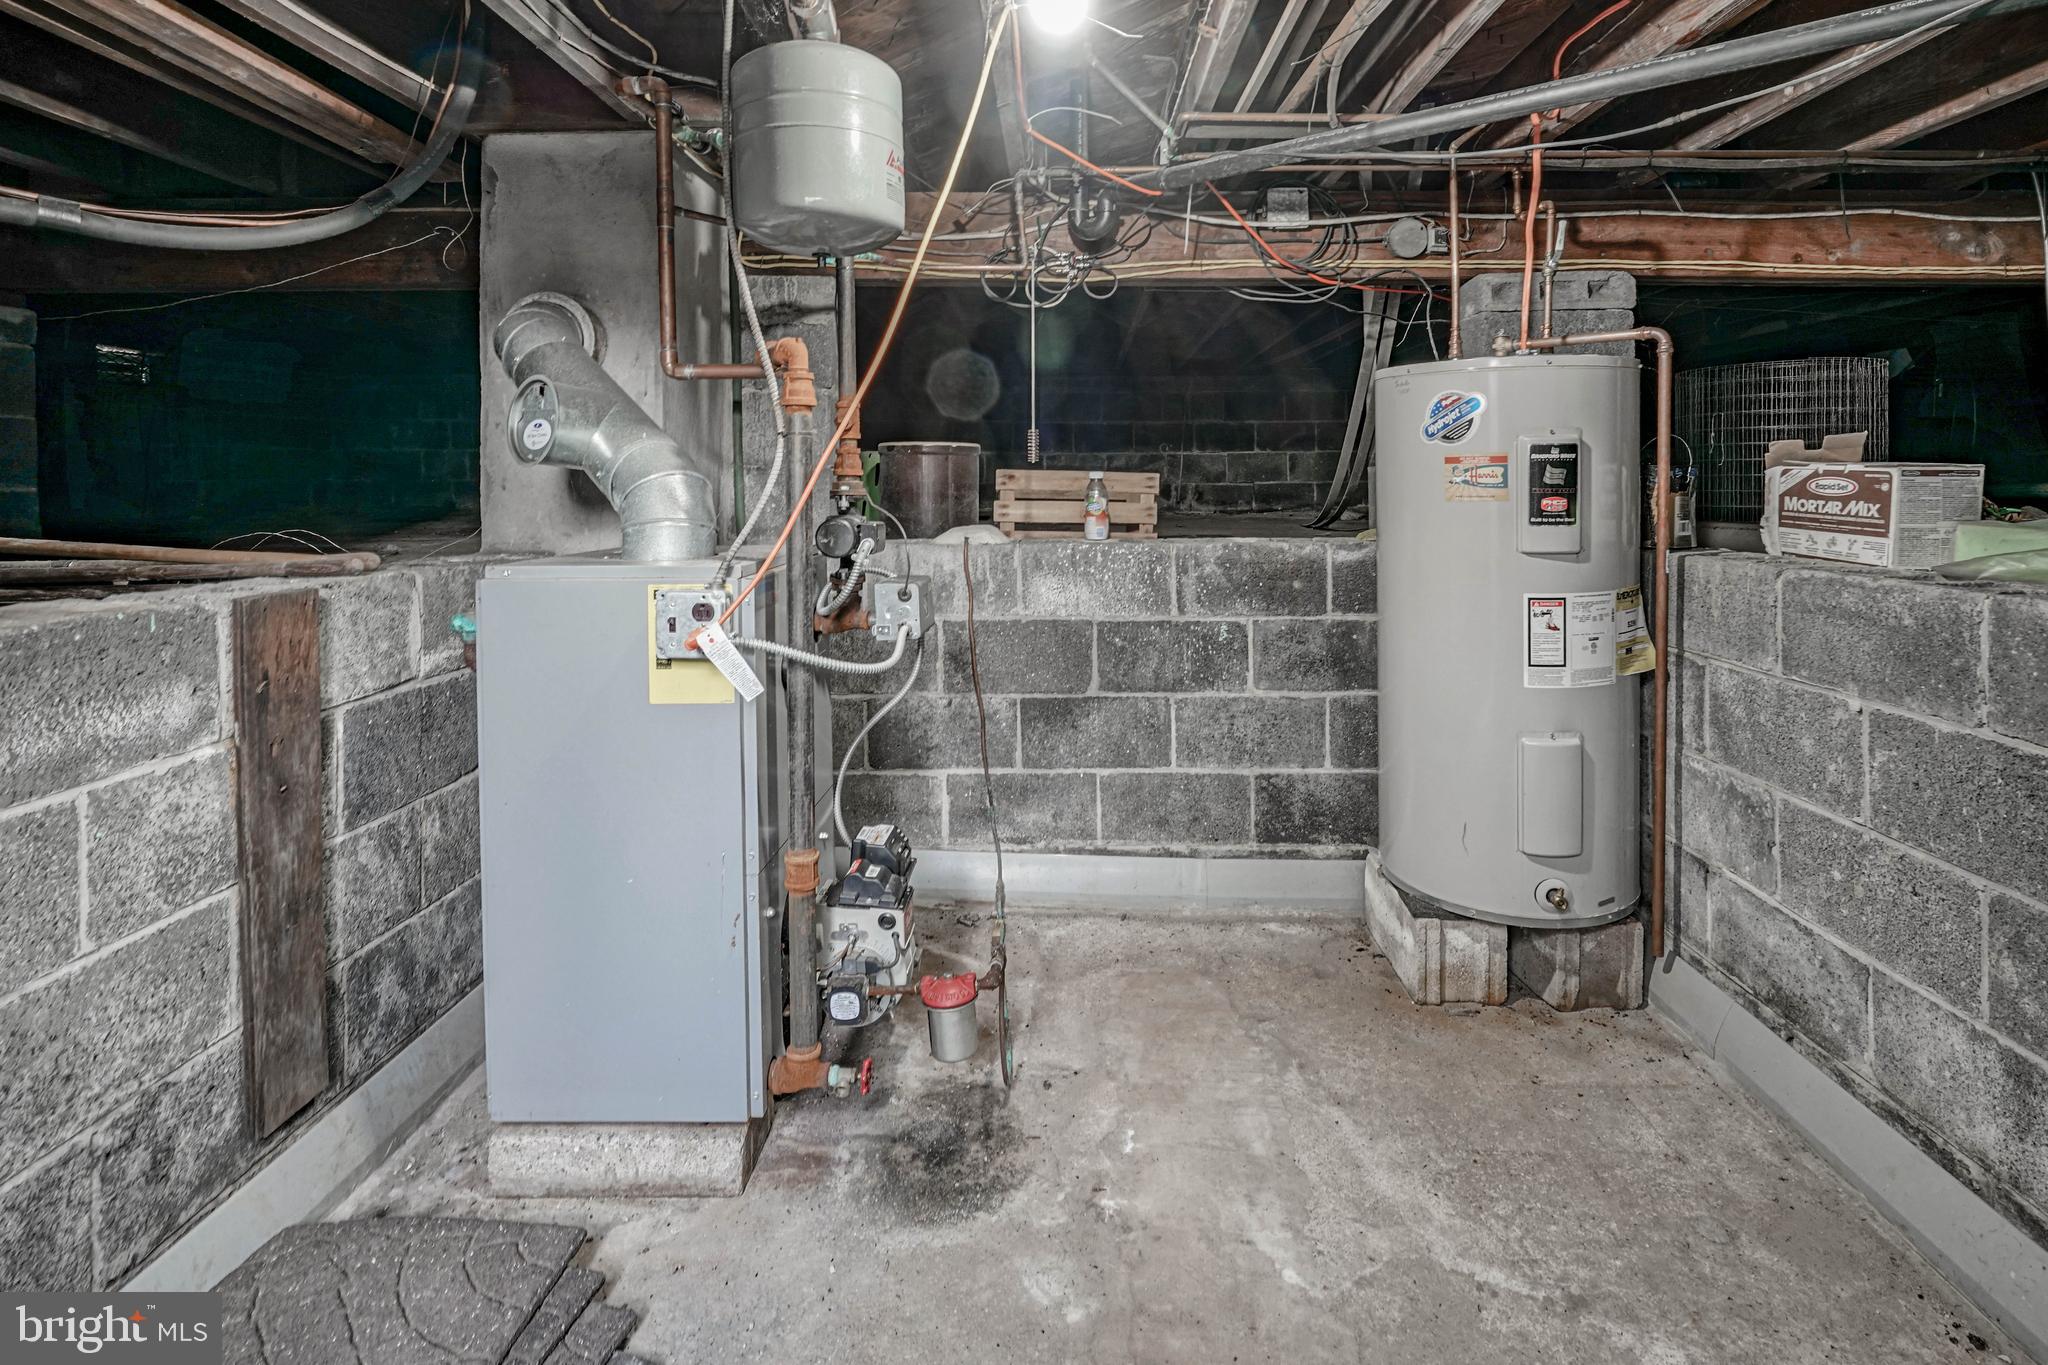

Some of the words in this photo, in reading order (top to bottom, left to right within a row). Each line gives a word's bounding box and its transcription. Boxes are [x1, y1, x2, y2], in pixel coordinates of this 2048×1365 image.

[1427, 408, 1461, 435] Hydrojet
[1469, 465, 1499, 484] Harris
[1815, 482, 1835, 492] Rapid
[1836, 482, 1849, 491] Set
[1783, 496, 1842, 514] MORTAR
[1841, 500, 1881, 518] MIX
